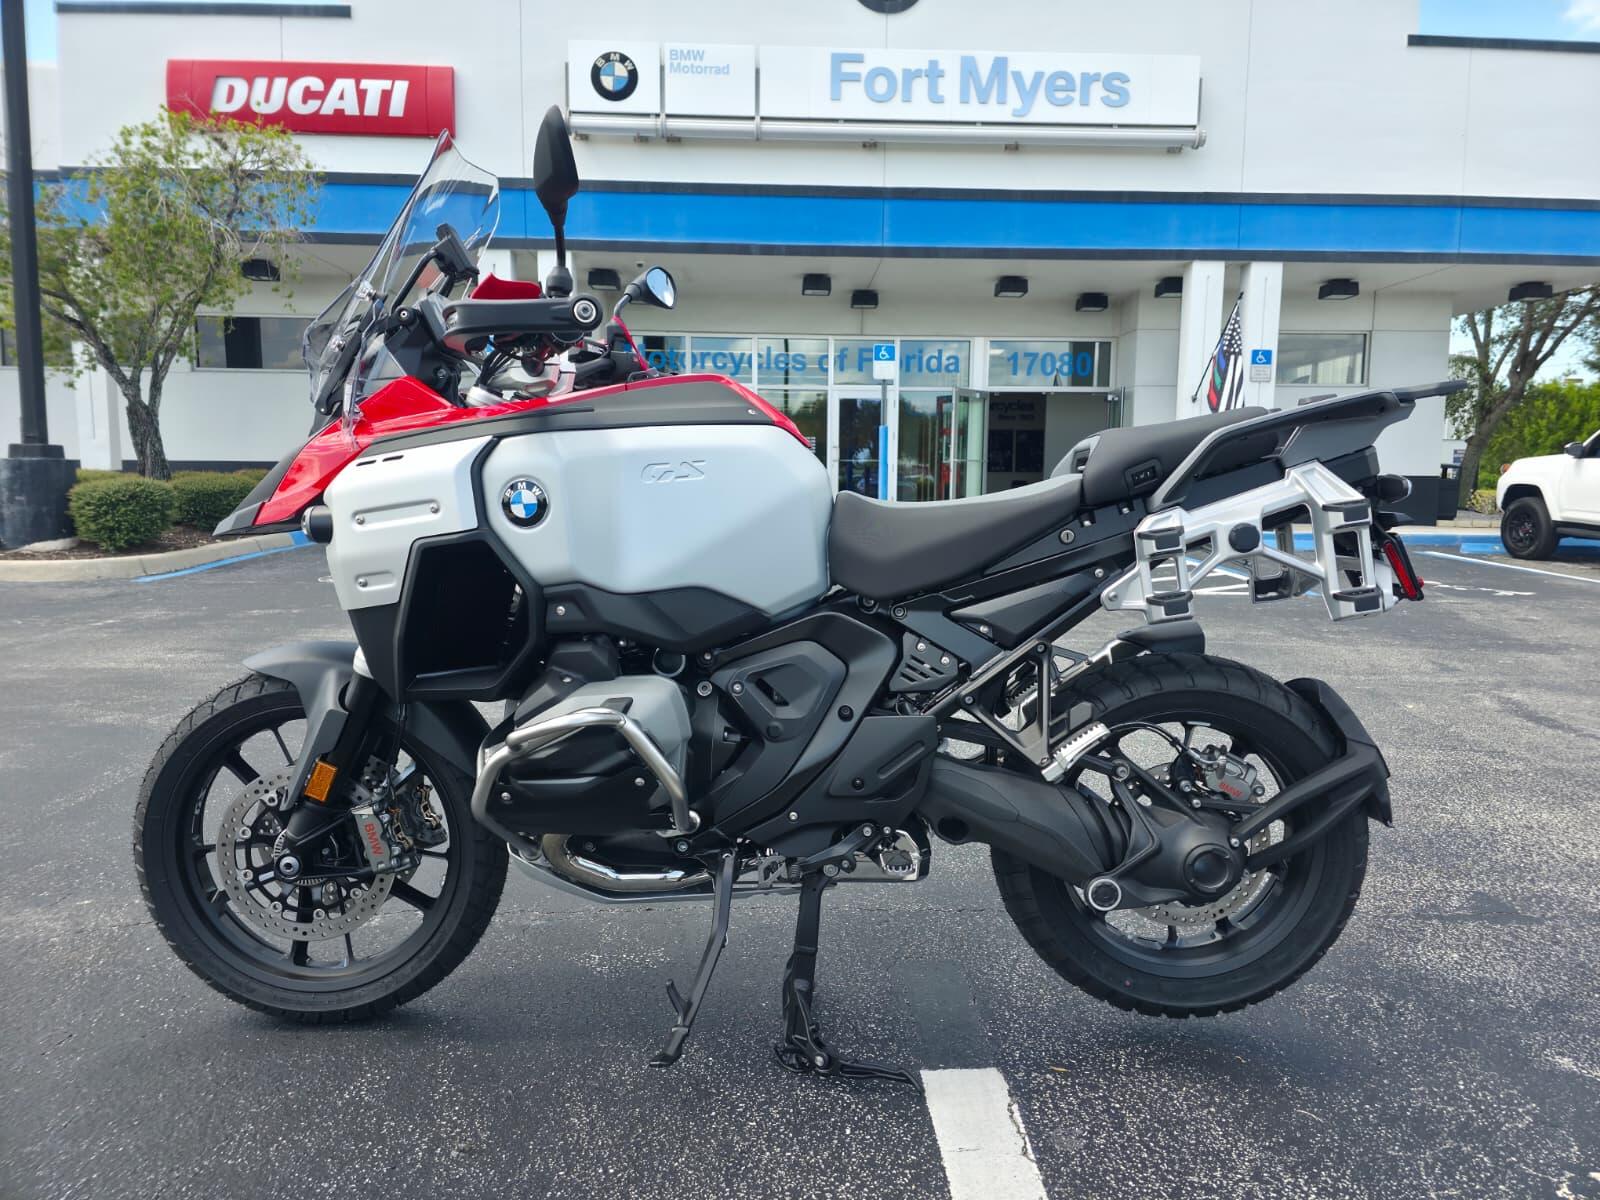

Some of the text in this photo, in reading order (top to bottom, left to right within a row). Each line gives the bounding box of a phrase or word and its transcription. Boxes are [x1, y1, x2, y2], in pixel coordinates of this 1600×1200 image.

[595, 52, 635, 72] BMW
[670, 50, 705, 61] BMW
[669, 63, 730, 76] Motorrad
[211, 75, 409, 118] DUCATI
[830, 52, 1131, 118] Fort Myers
[857, 346, 961, 374] Frida
[1007, 351, 1092, 377] 17080
[640, 459, 706, 484] GS
[504, 481, 542, 498] BMW
[1219, 783, 1243, 797] BMW
[365, 823, 384, 854] BMW
